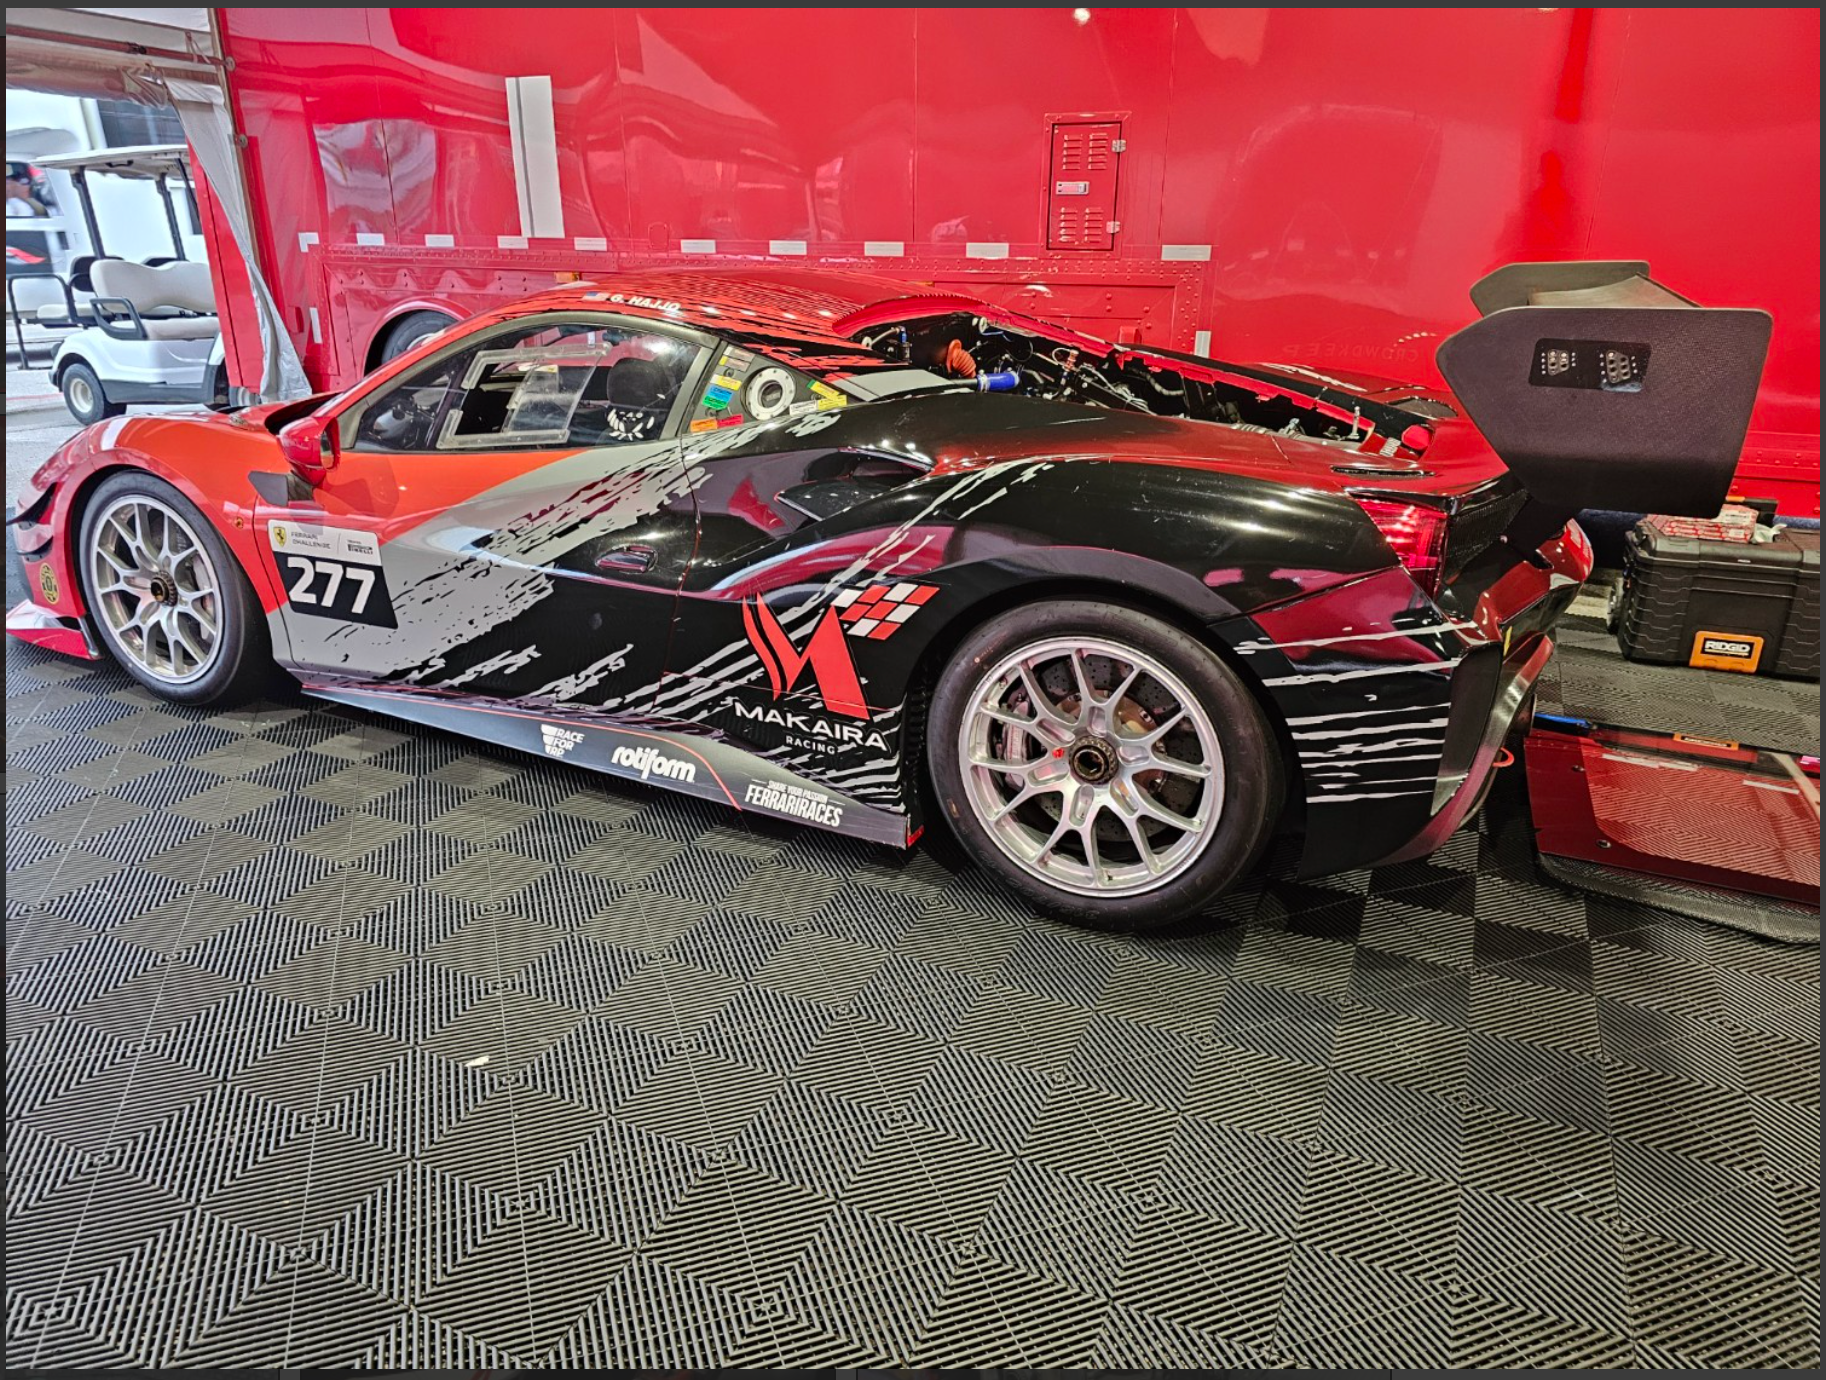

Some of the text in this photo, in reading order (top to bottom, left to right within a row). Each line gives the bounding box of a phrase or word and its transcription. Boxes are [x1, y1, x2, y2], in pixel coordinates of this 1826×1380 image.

[628, 296, 681, 310] HAJJO
[291, 531, 318, 540] FERRARI
[293, 539, 331, 549] CHALLENGE
[287, 556, 375, 614] 277
[1705, 640, 1750, 653] RIDGID
[734, 701, 888, 751] MAKAIRA
[556, 729, 585, 744] RACE
[554, 738, 575, 751] FOR
[786, 735, 836, 755] RACING
[611, 746, 696, 783] rotiform
[745, 784, 843, 827] FERRARIRACES
